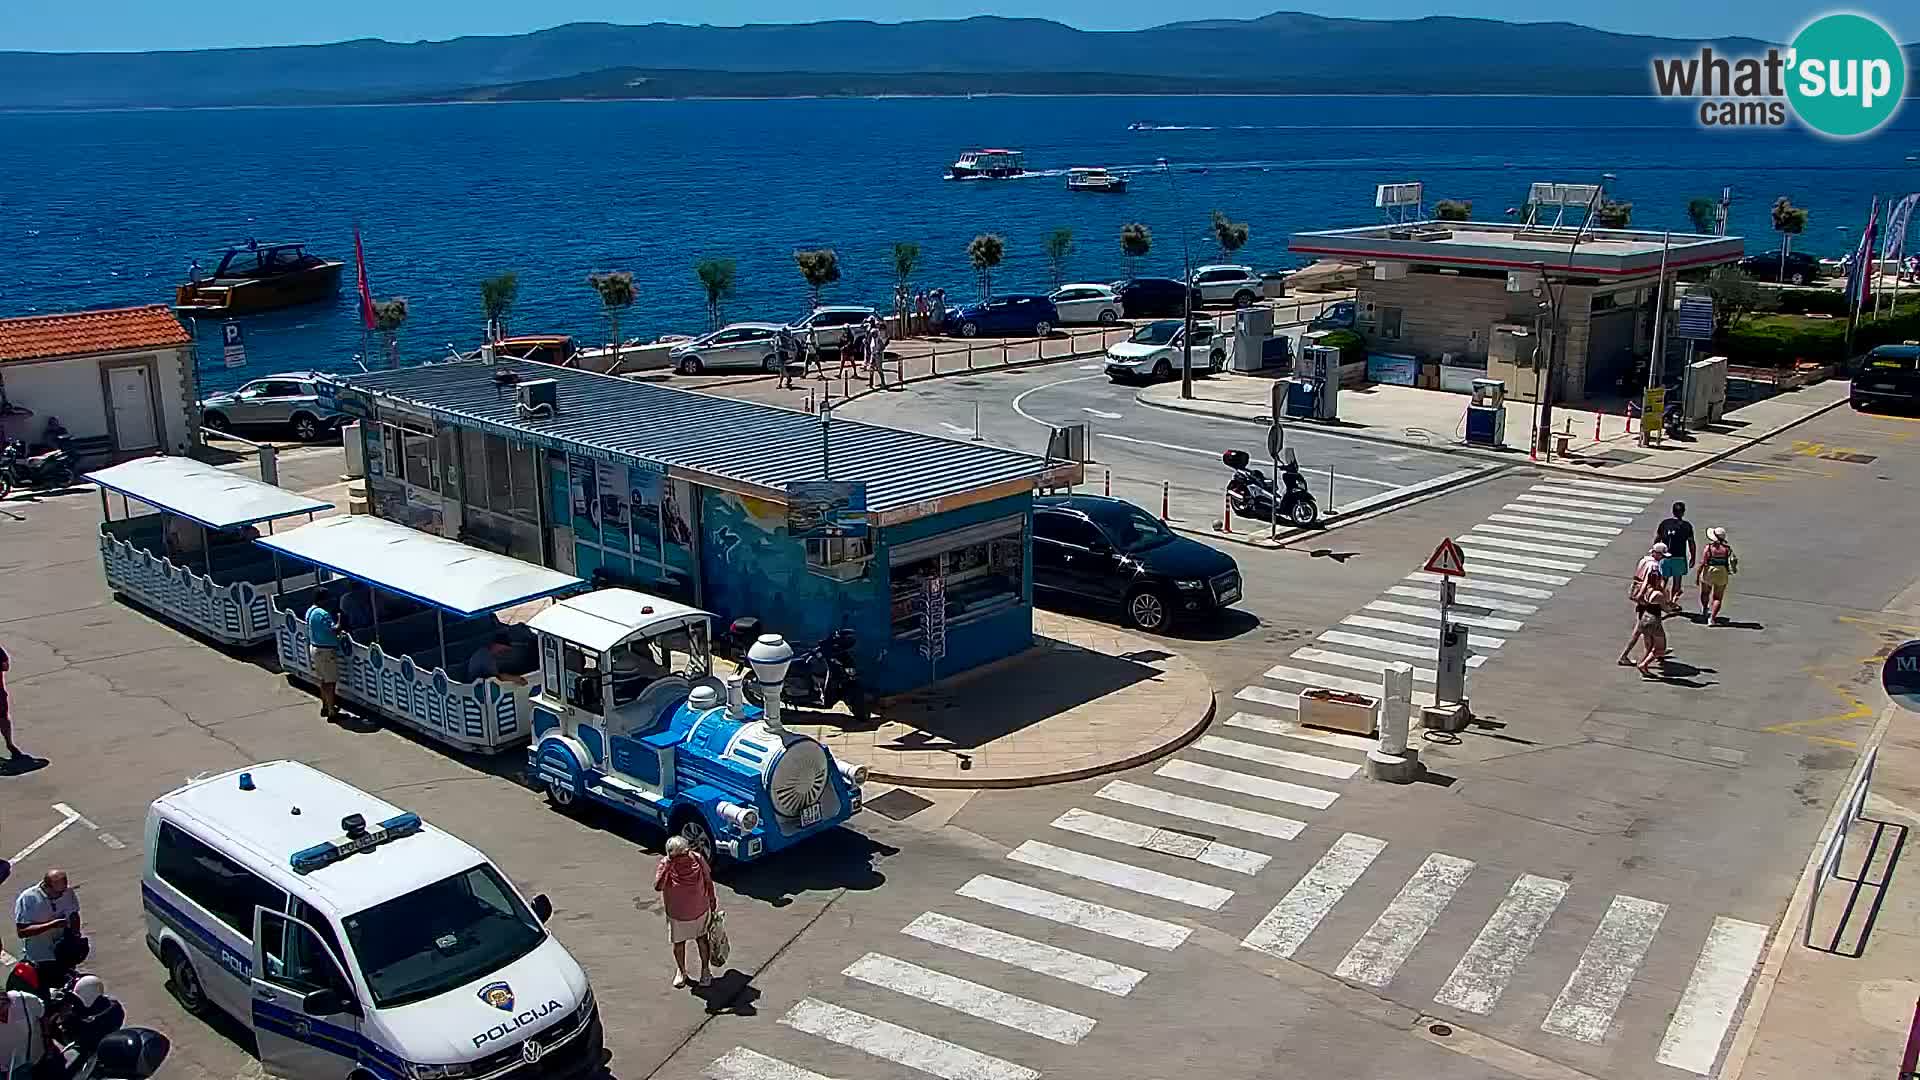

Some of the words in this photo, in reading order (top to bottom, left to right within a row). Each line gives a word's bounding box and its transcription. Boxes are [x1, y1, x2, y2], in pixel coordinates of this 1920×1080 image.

[225, 325, 238, 343] P
[578, 445, 610, 461] STATION
[612, 453, 638, 469] TICKET
[638, 459, 665, 474] OFFICE
[338, 831, 387, 856] POLICIJA
[471, 999, 564, 1049] POLICIJA
